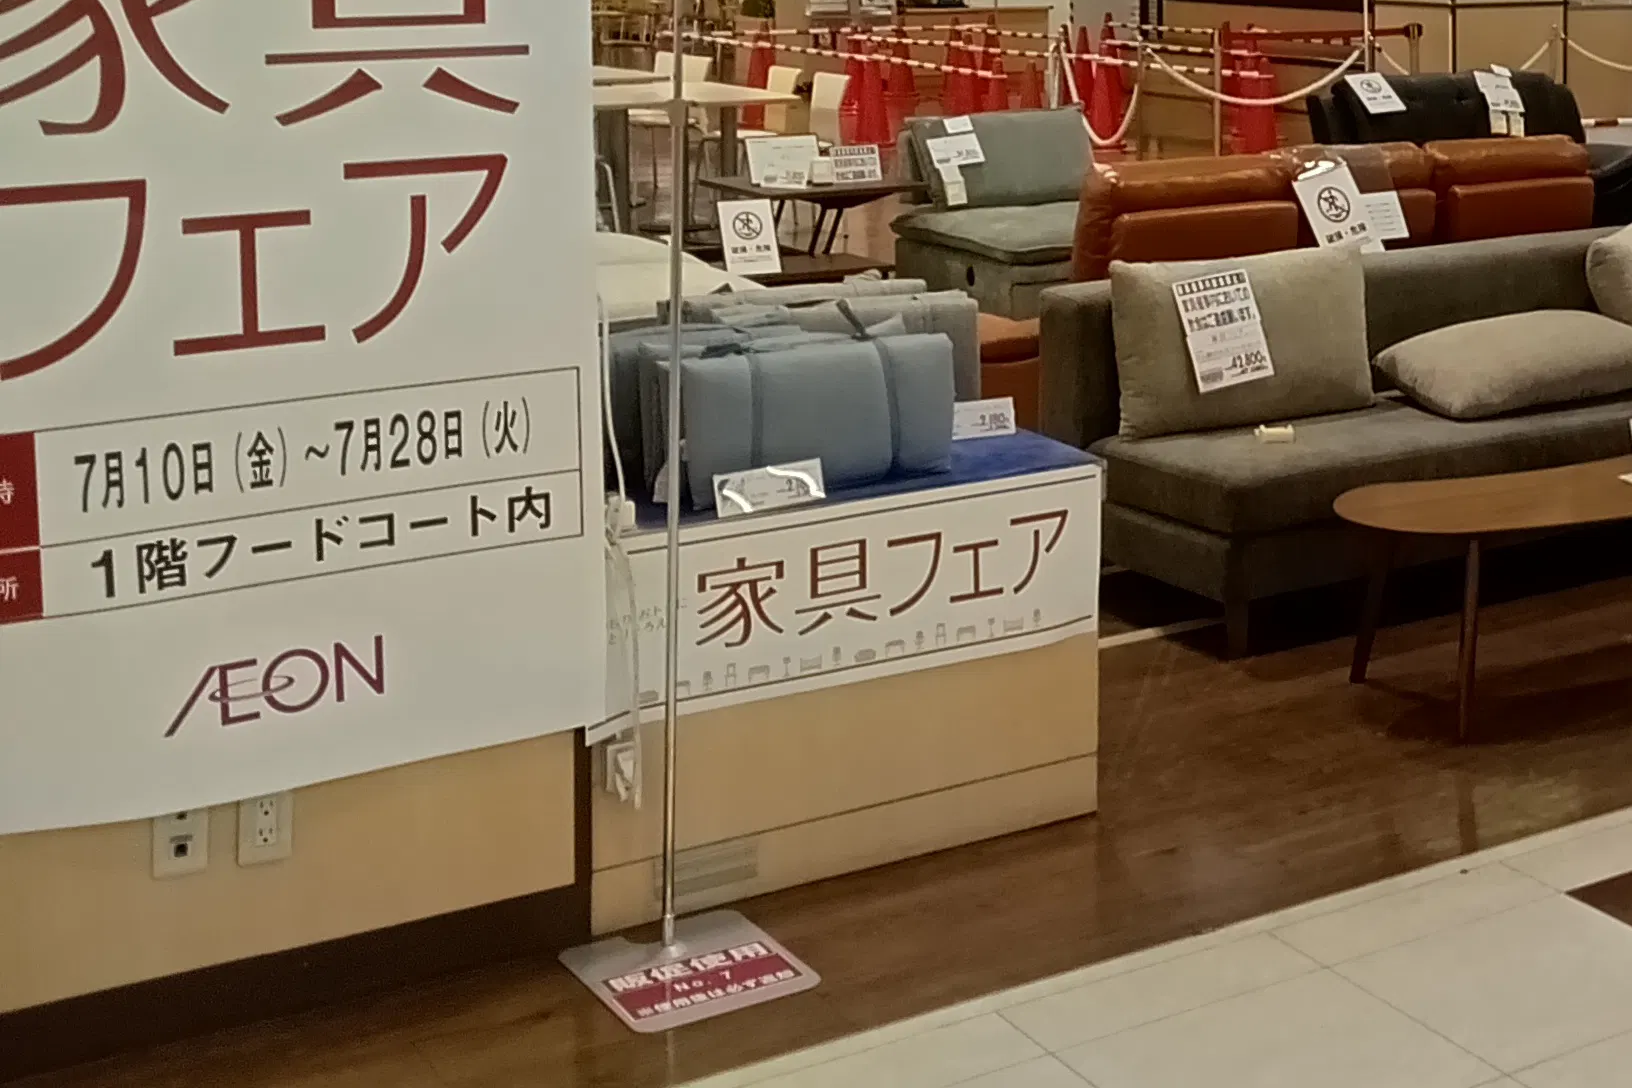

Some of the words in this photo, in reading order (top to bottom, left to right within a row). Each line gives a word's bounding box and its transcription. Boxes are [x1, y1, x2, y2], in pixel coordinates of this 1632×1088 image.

[0, 153, 508, 382] フェア
[91, 485, 552, 599] 1階フードコート内
[695, 509, 1069, 648] 家具フェア
